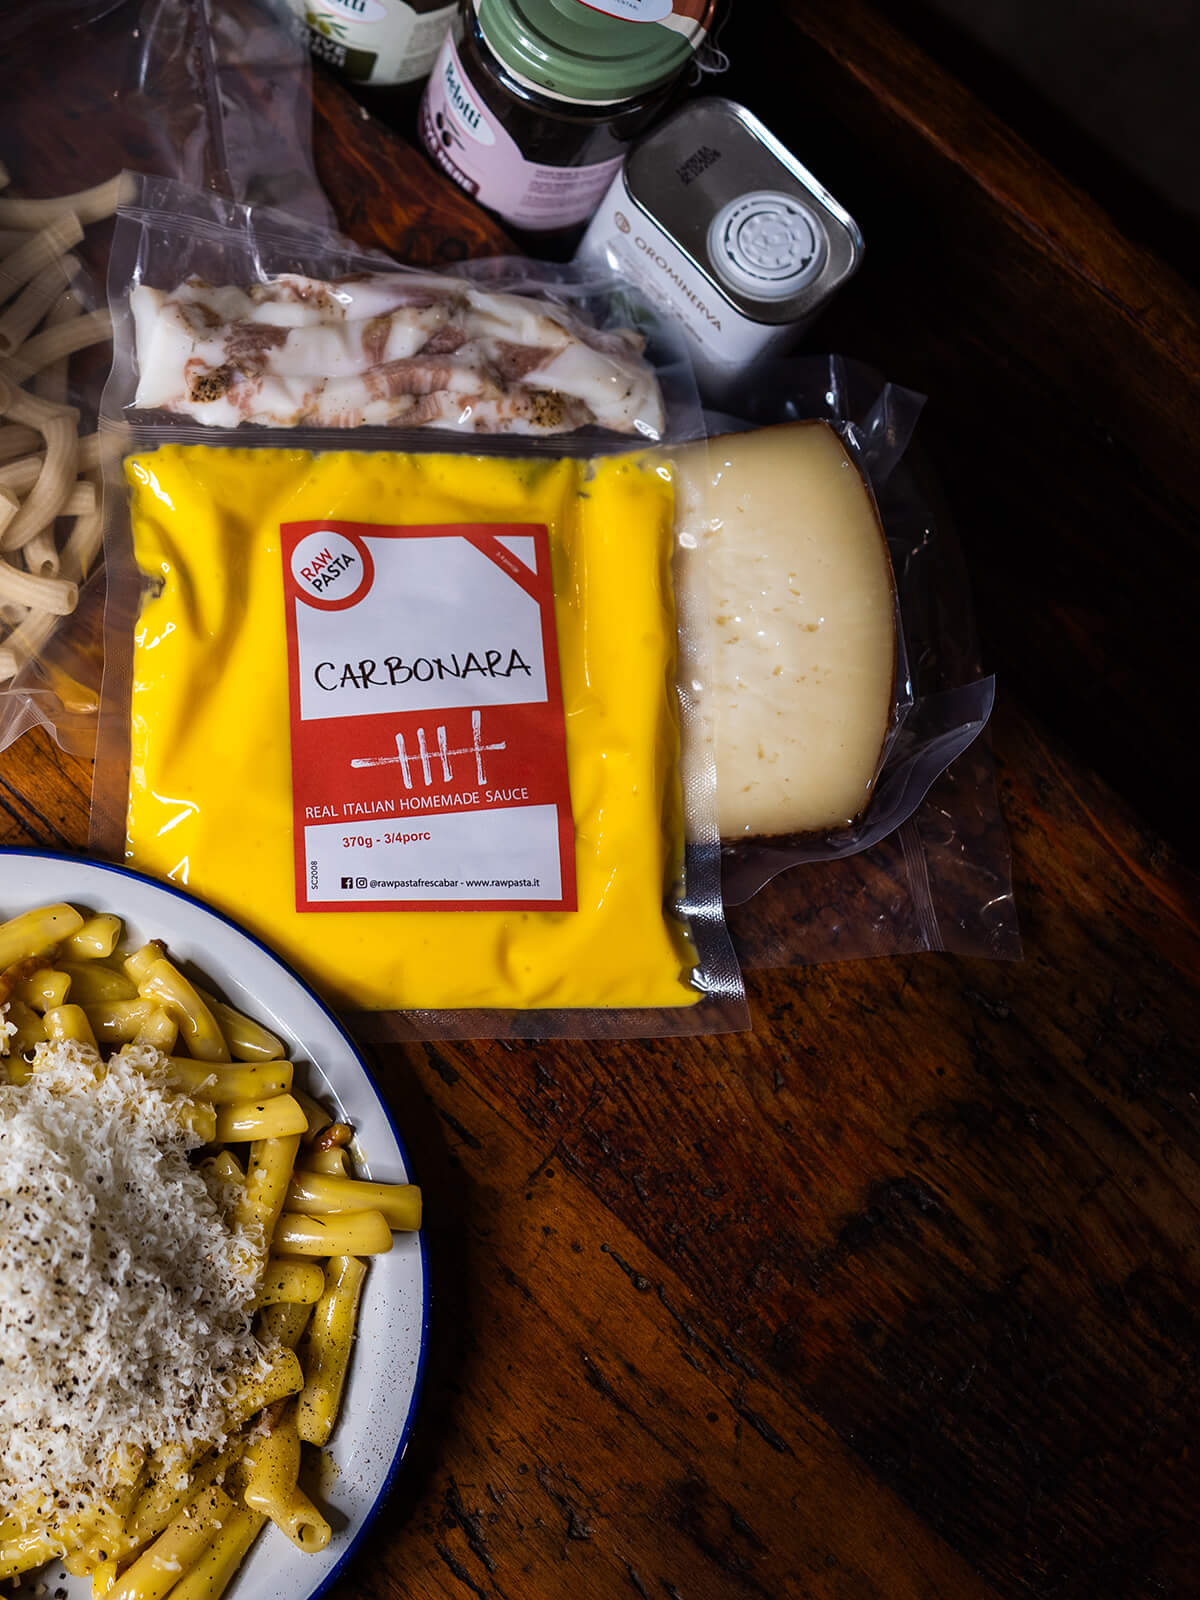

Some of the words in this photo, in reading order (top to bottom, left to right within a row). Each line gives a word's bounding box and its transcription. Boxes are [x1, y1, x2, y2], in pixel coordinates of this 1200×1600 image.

[444, 60, 482, 128] Belotti
[634, 236, 722, 331] OROMINERVA
[300, 547, 333, 582] RAW
[311, 553, 356, 593] PASTA
[314, 648, 532, 691] CARBONARA
[304, 804, 340, 820] REAL
[342, 799, 396, 817] ITALIAN
[399, 792, 480, 810] HOMEMADE
[485, 786, 530, 802] SAUCE
[342, 832, 374, 849] 370g
[384, 830, 432, 846] 3/4porc
[310, 860, 319, 891] SC2008
[369, 876, 459, 890] @rawpastafrescabar
[465, 876, 540, 890] www.rawpasta.it
